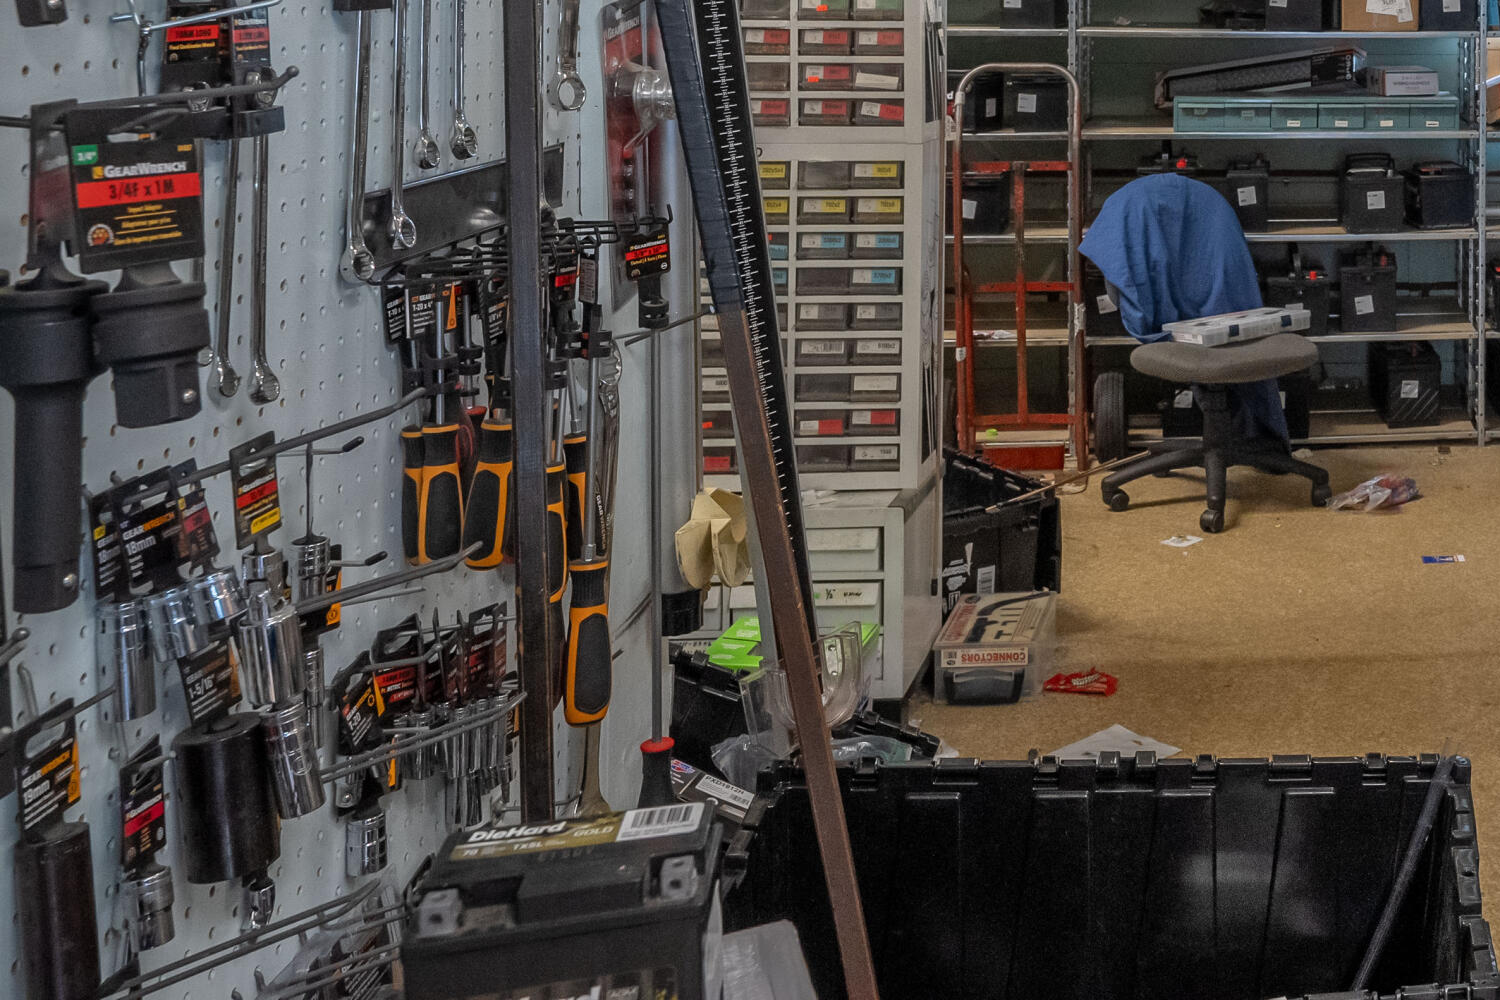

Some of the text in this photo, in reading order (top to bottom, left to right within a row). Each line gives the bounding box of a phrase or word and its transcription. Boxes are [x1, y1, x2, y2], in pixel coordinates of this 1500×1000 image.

[104, 161, 187, 178] GEARWRENCH
[109, 179, 175, 201] 3/4F x 1M
[634, 239, 667, 250] GEARWRENCH
[412, 303, 423, 312] T-20
[122, 511, 175, 540] GEARWRENCH
[960, 651, 1026, 663] CONNECTORS
[22, 779, 50, 803] 19mm
[704, 775, 745, 796] PXD1912H
[468, 821, 566, 844] DieHard
[574, 825, 613, 838] GOLD
